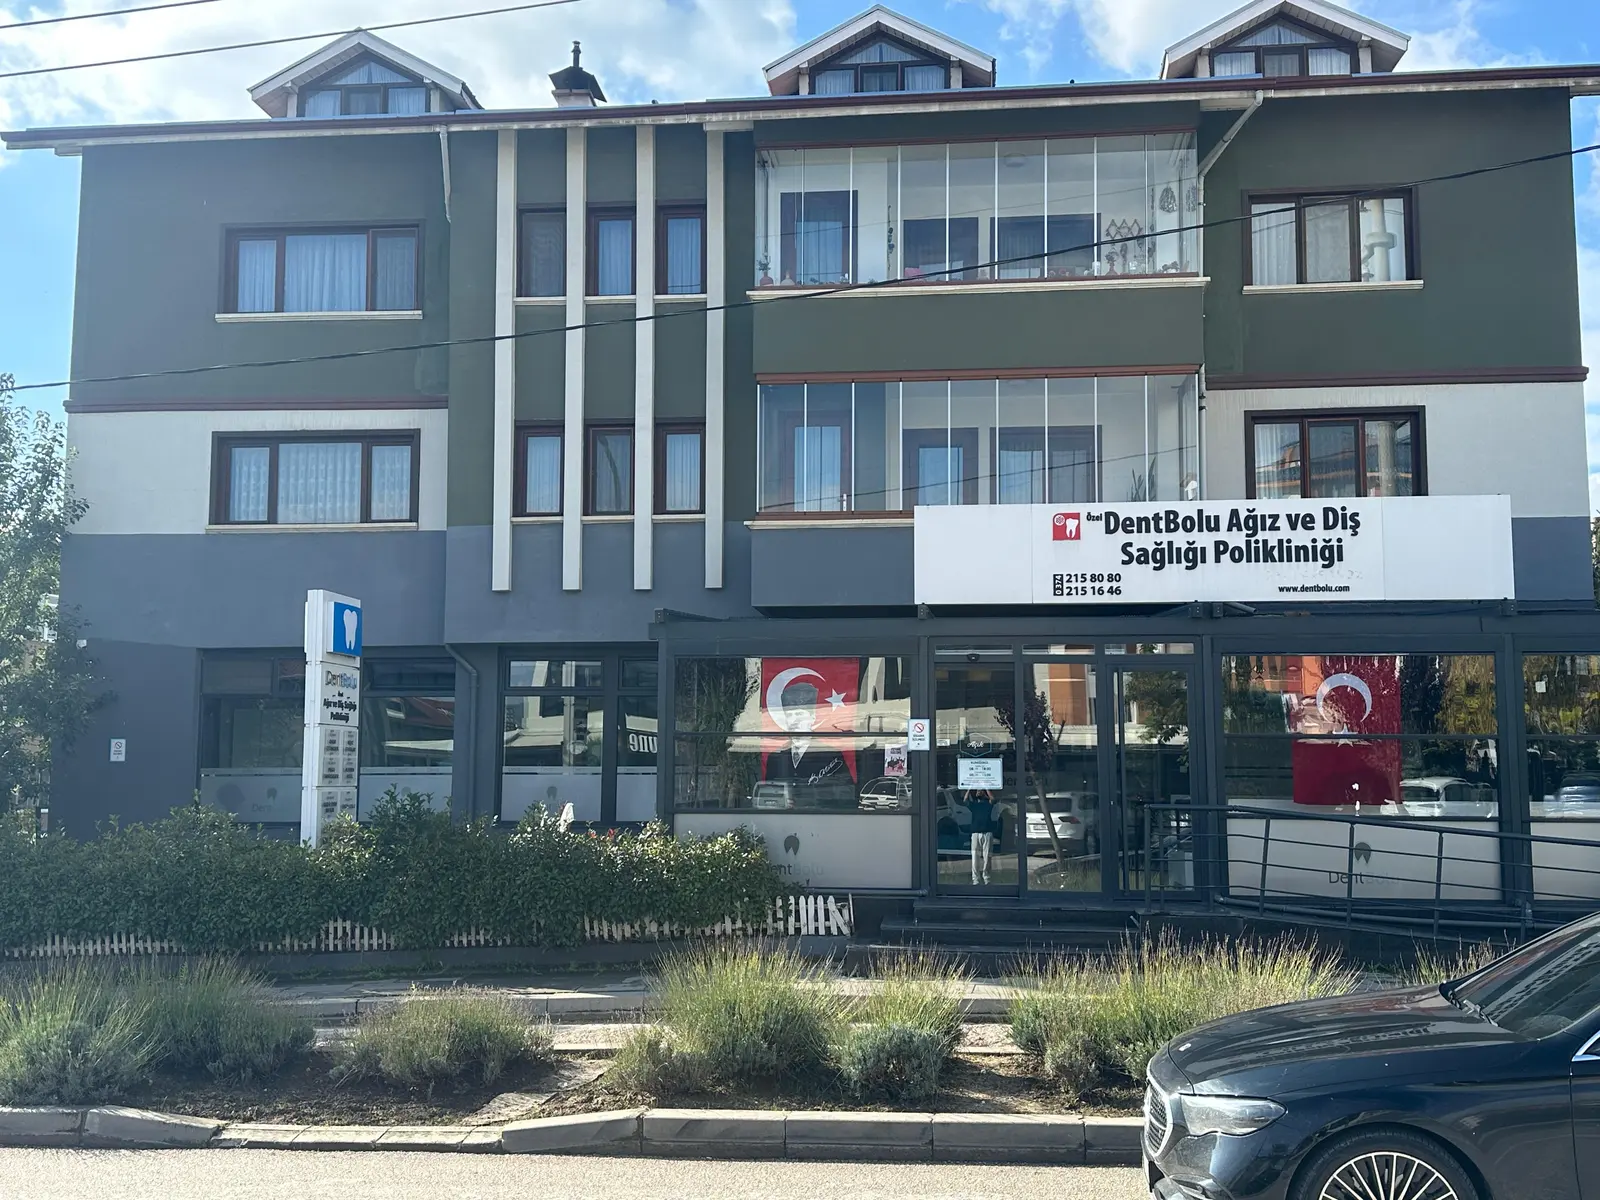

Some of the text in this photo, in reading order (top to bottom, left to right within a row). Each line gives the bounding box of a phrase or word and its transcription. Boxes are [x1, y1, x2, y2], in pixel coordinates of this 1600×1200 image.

[1086, 505, 1361, 538] Özel DentBolu Ağız ve Diş
[1120, 537, 1344, 571] Sağlığı Polikliniği
[1054, 575, 1063, 595] 0374
[1065, 573, 1122, 583] 215 80 80
[1065, 586, 1122, 596] 215 16 46
[1278, 584, 1350, 593] www.dentbolu.com
